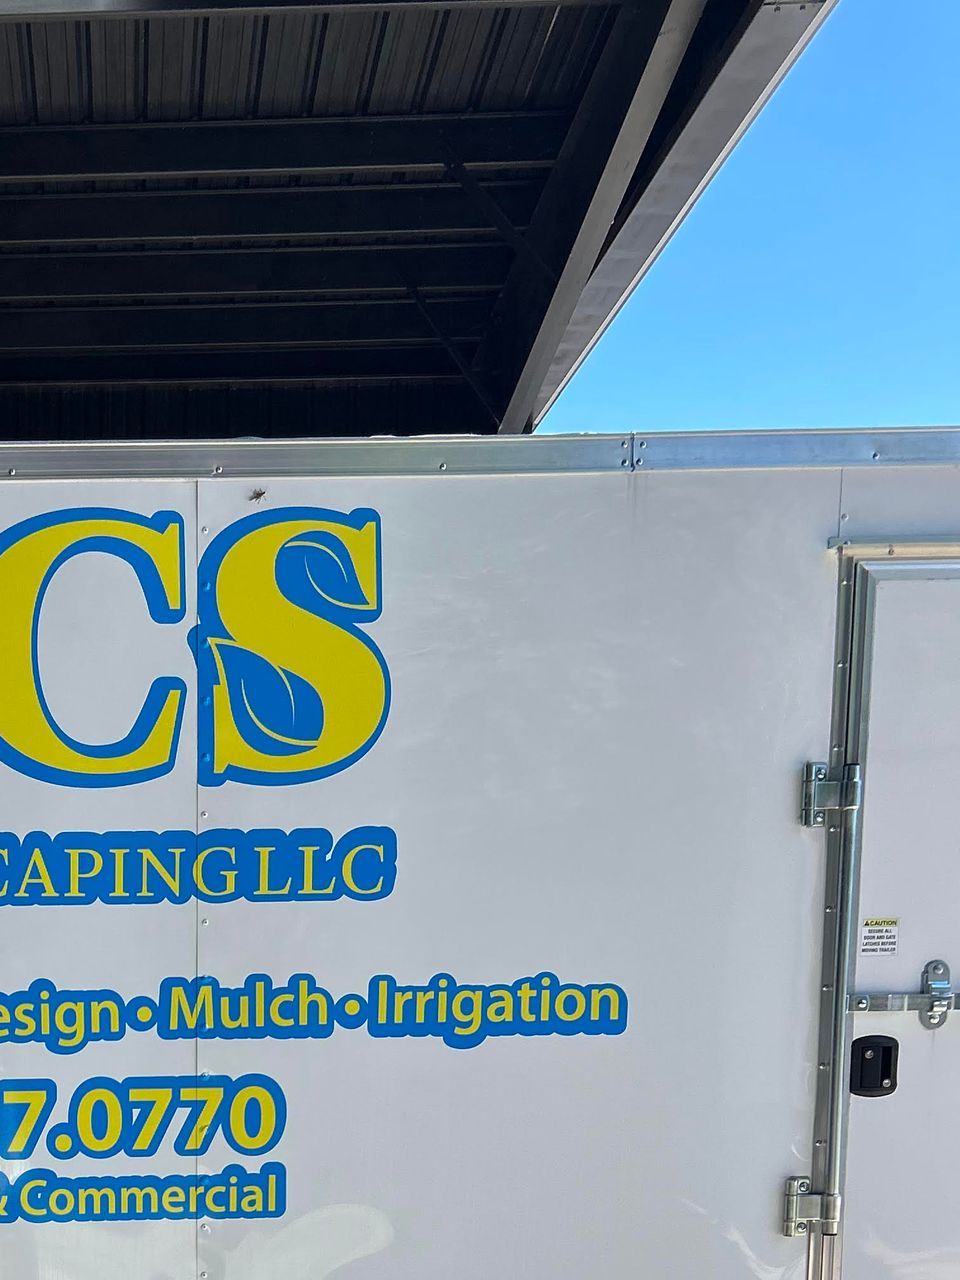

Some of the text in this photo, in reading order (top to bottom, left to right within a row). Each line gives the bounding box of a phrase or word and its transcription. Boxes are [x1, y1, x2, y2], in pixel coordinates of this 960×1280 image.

[253, 843, 387, 896] LLC
[168, 979, 330, 1031] Mulch
[376, 976, 621, 1036] Irrigation
[18, 1174, 278, 1216] Commercial
